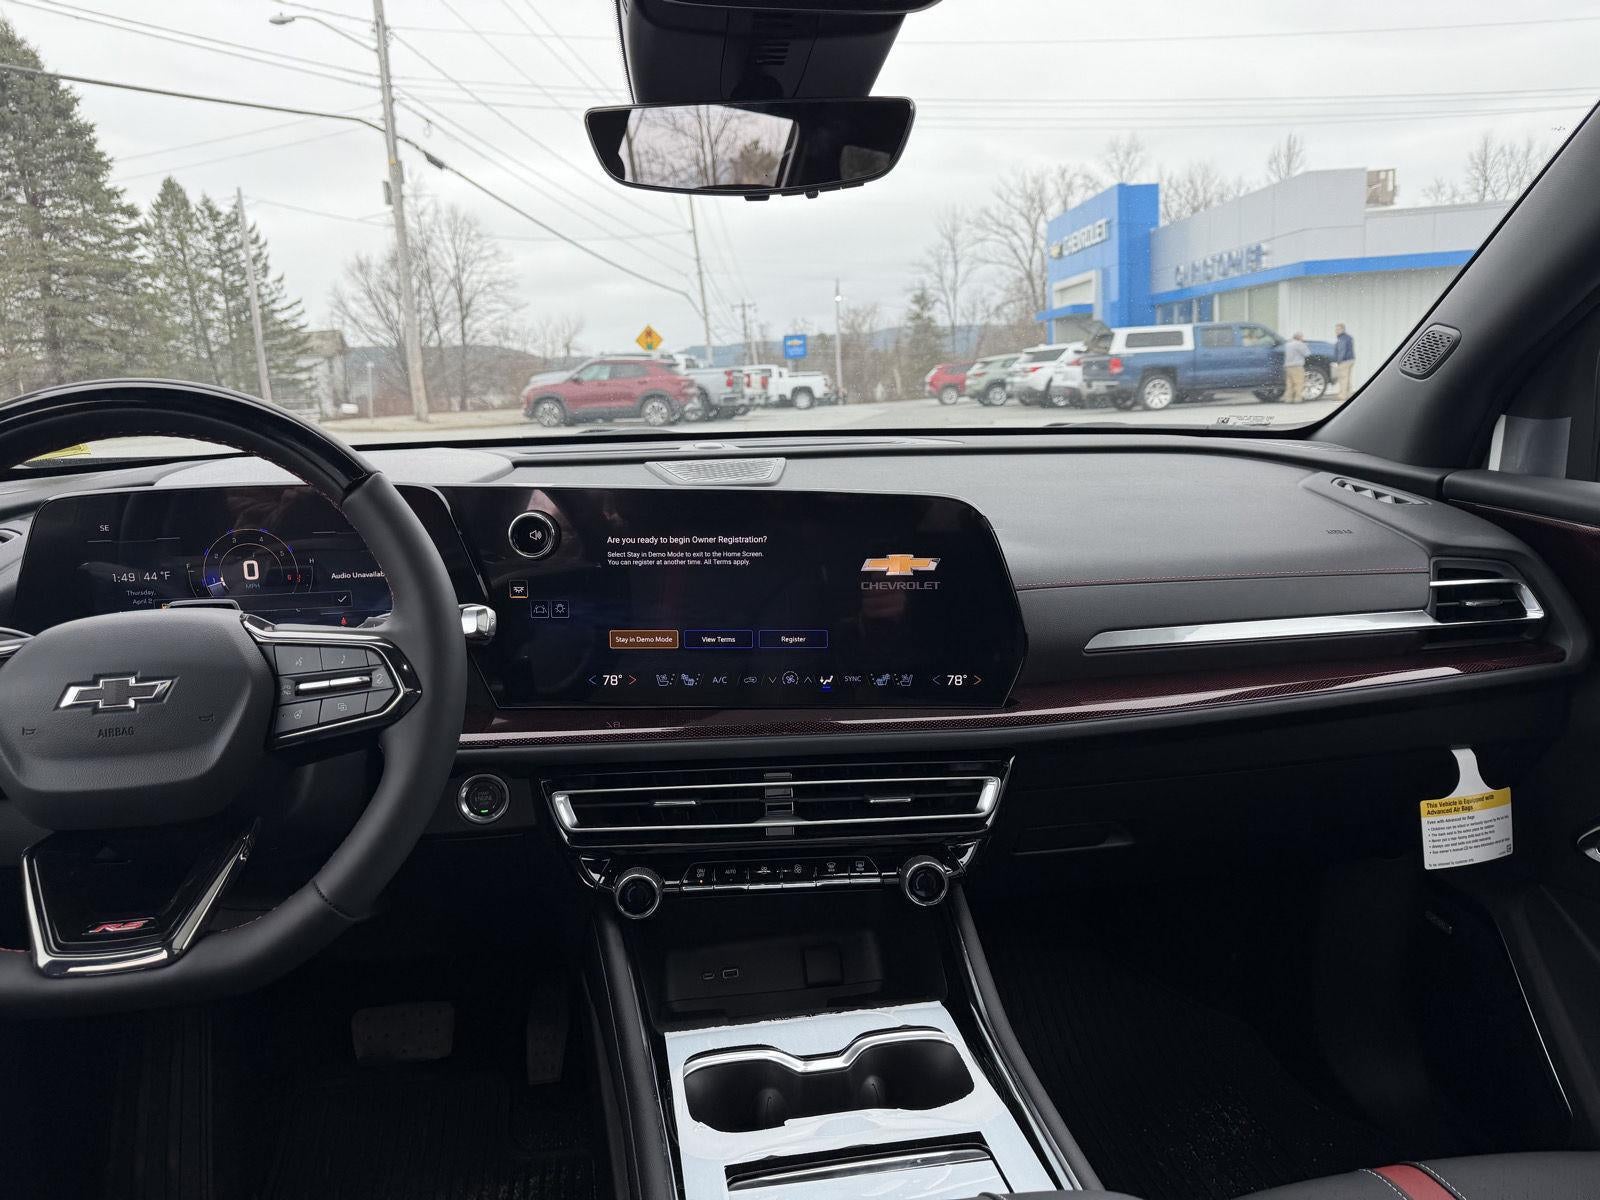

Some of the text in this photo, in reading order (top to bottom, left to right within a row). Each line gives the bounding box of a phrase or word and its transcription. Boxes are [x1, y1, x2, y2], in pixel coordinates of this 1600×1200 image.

[99, 524, 110, 532] SE
[606, 536, 768, 546] Are you ready to begin Owner Registration?
[626, 551, 640, 559] Stay
[703, 558, 712, 566] All
[713, 558, 732, 566] Terms
[733, 558, 751, 567] apply.
[242, 559, 260, 581] 0
[112, 572, 136, 583] 1:49
[143, 571, 158, 581] 44
[331, 572, 351, 580] Audio
[245, 582, 261, 590] MPH
[860, 581, 941, 590] CHEVROLET
[615, 635, 673, 644] Stay in Demo Mode
[701, 635, 736, 643] View Terms
[781, 635, 806, 644] Register
[602, 674, 623, 686] 78°
[712, 675, 727, 684] A/C
[946, 674, 968, 686] 78°
[97, 726, 135, 738] AIRBAG
